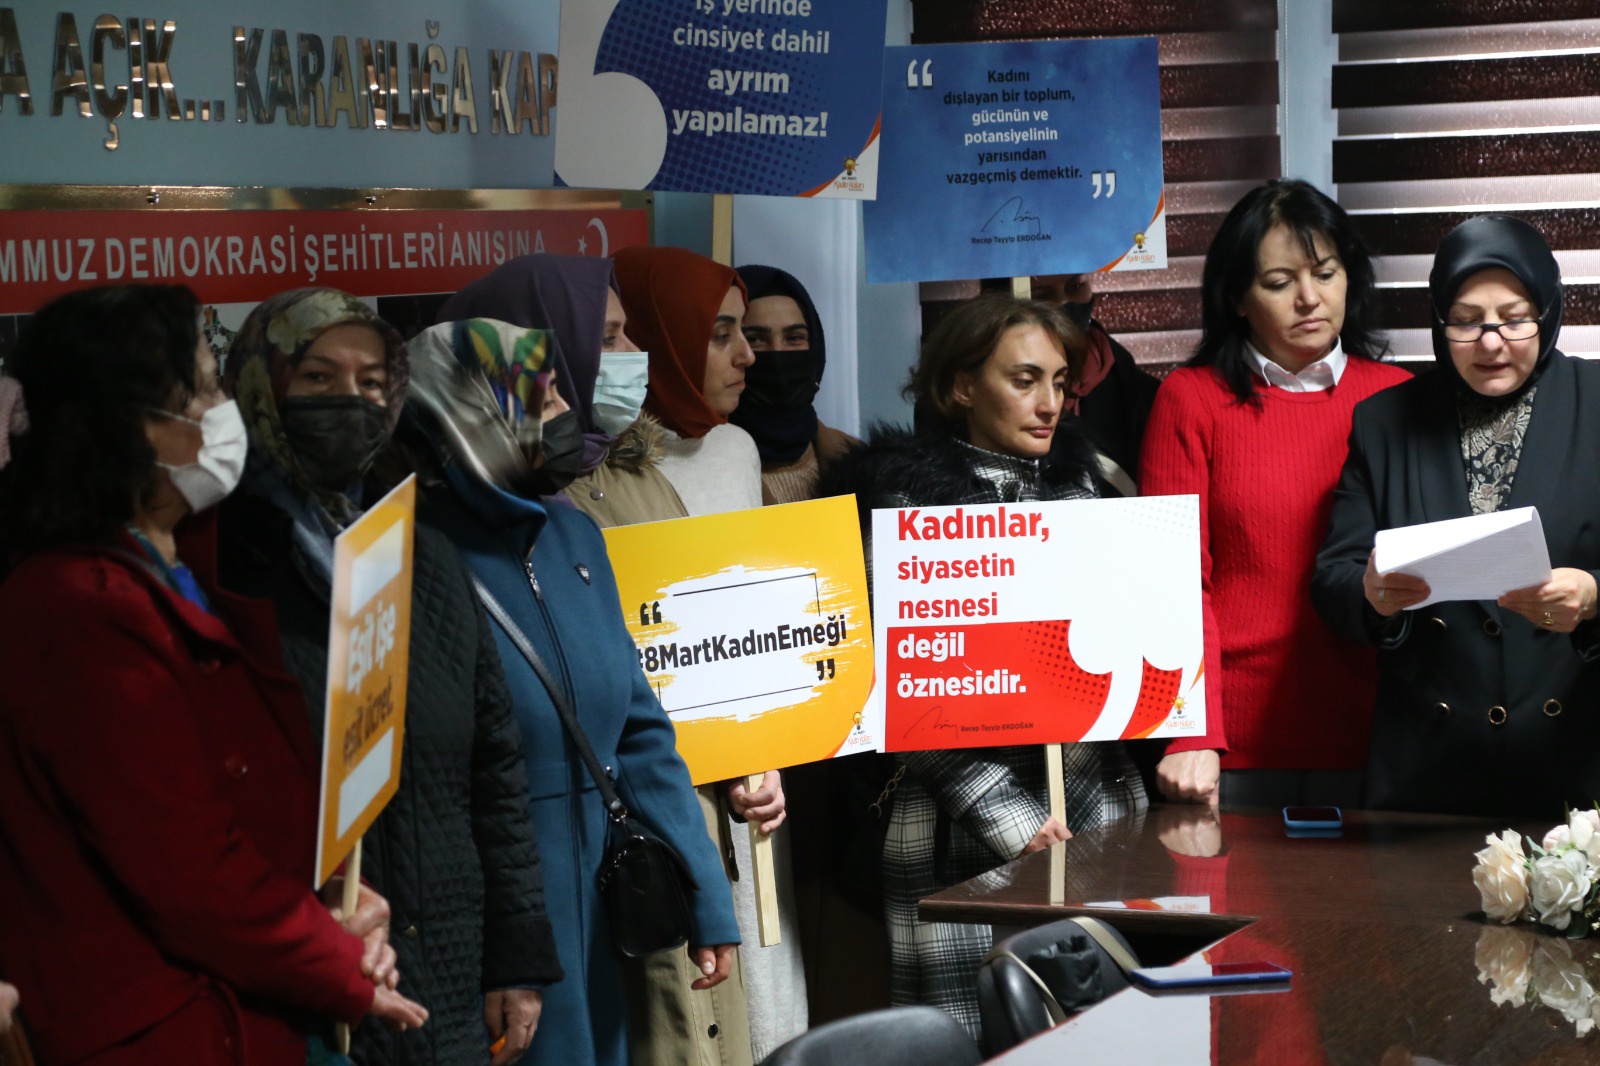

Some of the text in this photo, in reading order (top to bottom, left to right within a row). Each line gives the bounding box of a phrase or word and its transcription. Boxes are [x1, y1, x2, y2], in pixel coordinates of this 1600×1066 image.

[672, 22, 830, 54] cinsiyet dahil
[51, 12, 225, 150] AÇIK...
[232, 20, 479, 135] KARANLIĞA
[707, 68, 790, 96] ayrım
[987, 69, 1030, 84] Kadını
[943, 88, 1076, 106] dışlayan bir toplum,
[671, 106, 829, 138] yapılamaz!
[972, 109, 1049, 126] gücünün ve
[964, 126, 1058, 146] potansiyelinin
[977, 148, 1047, 165] yarısından
[946, 165, 1083, 185] vazgeçmiş demektir.
[105, 225, 297, 280] DEMOKRASİ
[304, 222, 445, 282] ŞEHİTLERİ
[450, 230, 547, 267] ANISINA
[897, 506, 1050, 543] Kadınlar,
[897, 552, 1015, 584] siyasetin
[898, 591, 998, 619] nesnesi
[897, 631, 965, 663] değil
[896, 668, 1027, 699] öznesidir.
